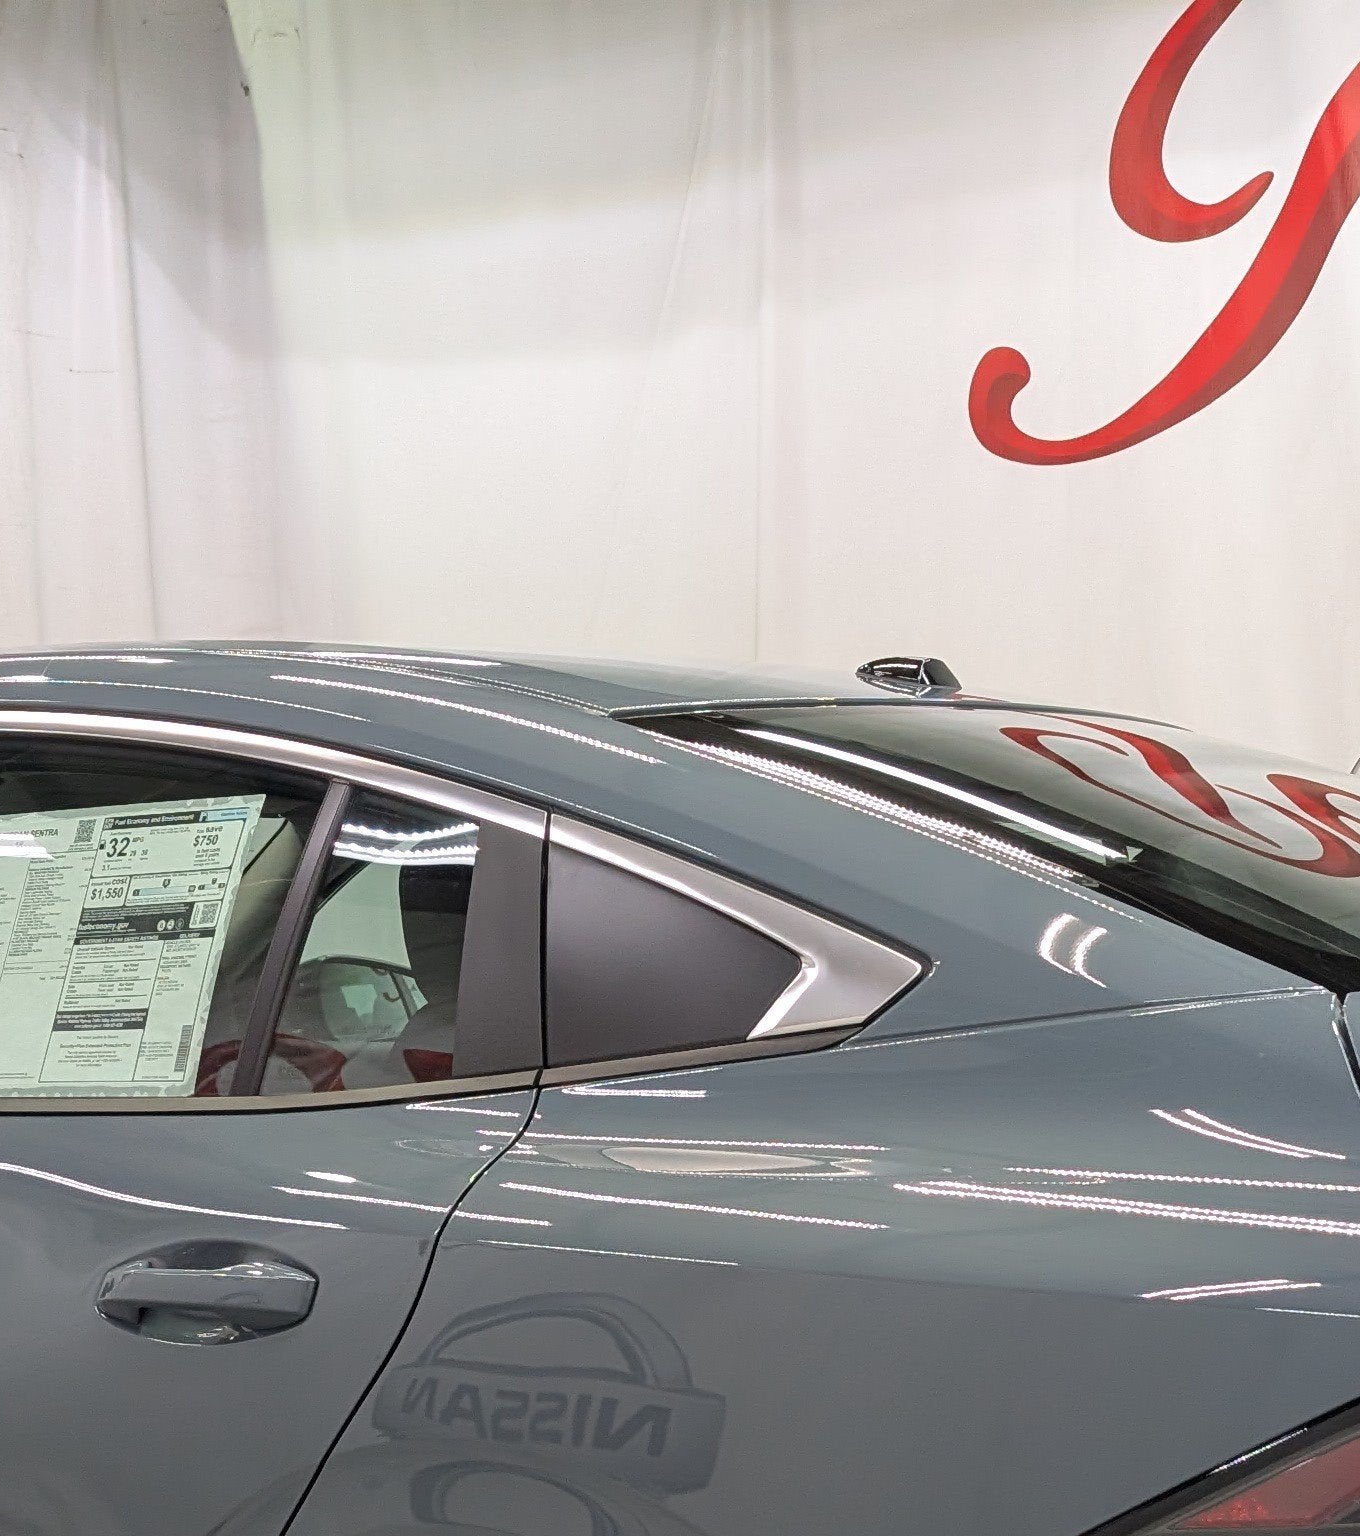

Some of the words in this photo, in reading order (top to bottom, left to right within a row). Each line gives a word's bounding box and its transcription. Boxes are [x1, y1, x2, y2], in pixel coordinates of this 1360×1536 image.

[106, 836, 131, 858] 32
[193, 834, 219, 847] $750
[90, 886, 124, 901] $1,550
